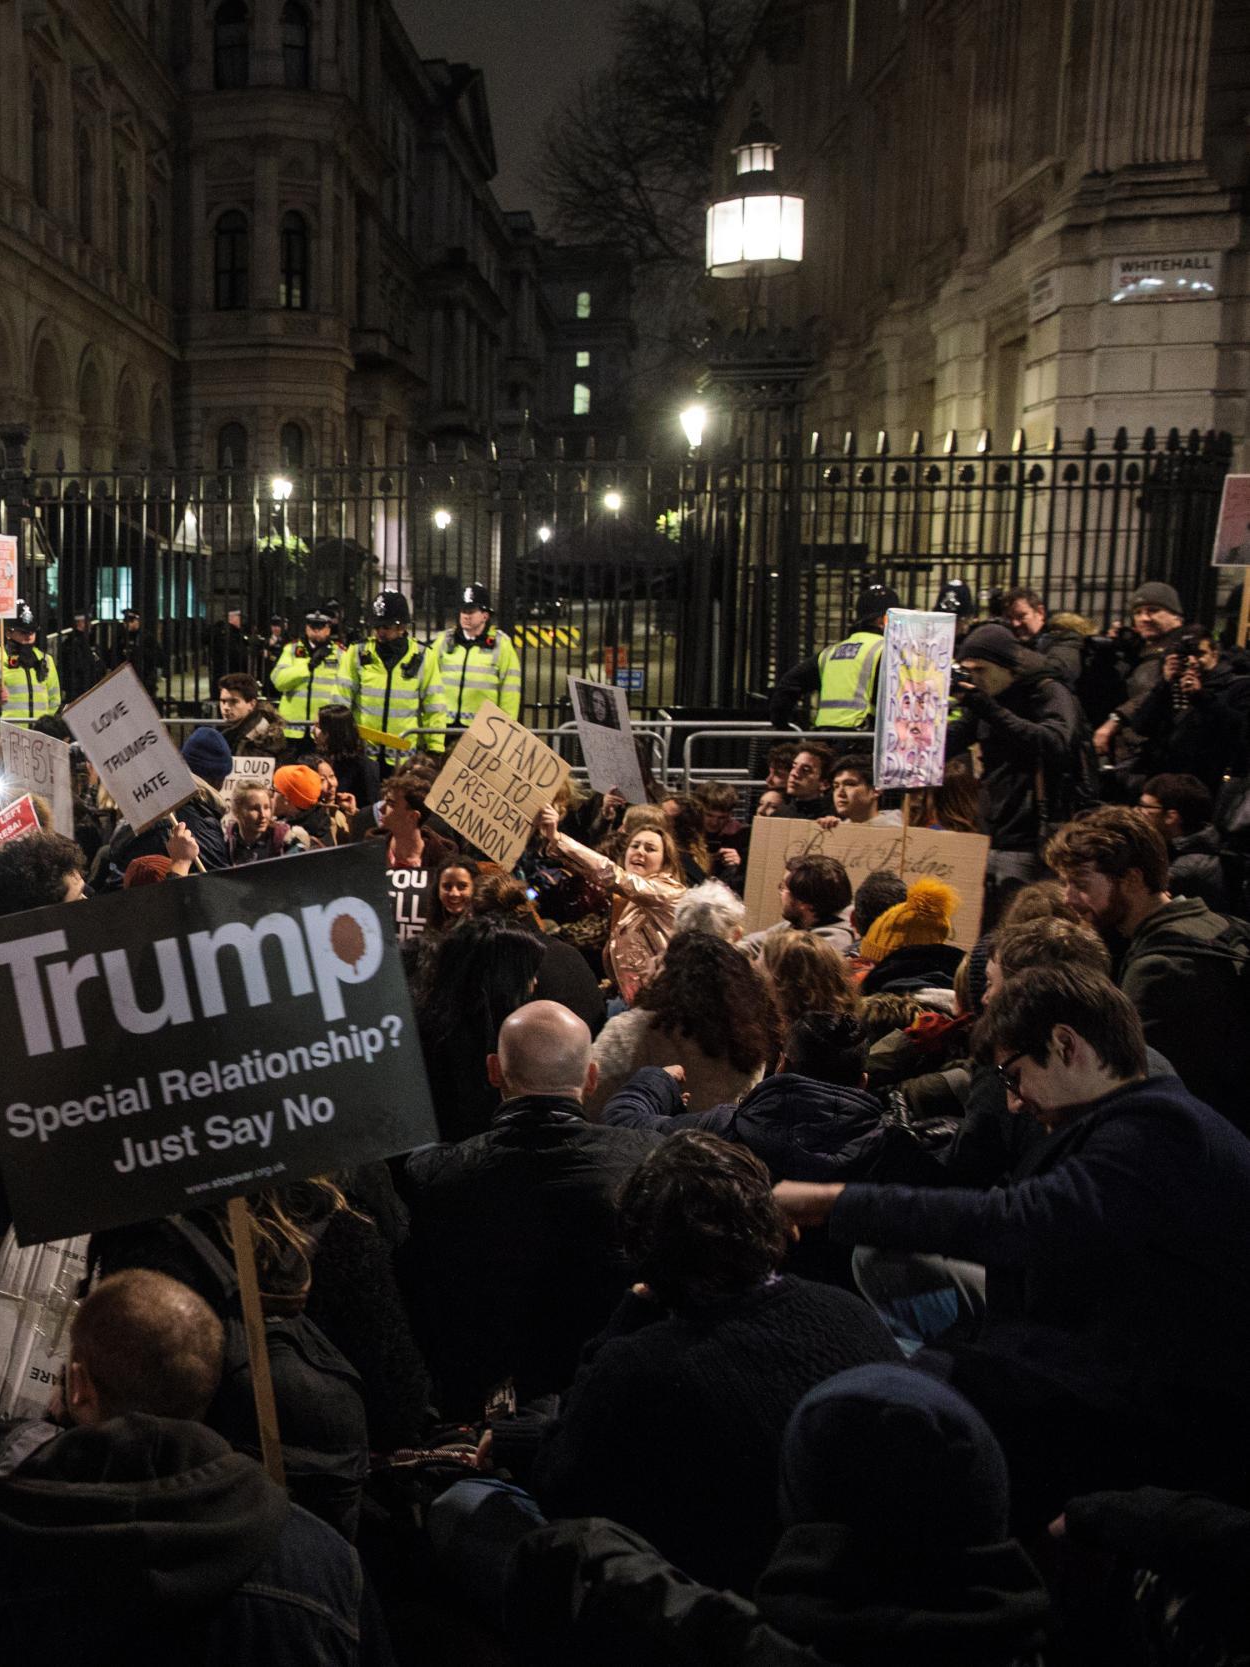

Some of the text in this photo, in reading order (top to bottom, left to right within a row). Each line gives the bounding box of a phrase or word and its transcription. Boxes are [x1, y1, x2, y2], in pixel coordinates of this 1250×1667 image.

[1120, 257, 1213, 273] WHITEHALL
[91, 699, 130, 735] LOVE
[103, 730, 159, 774] TRUMPS
[234, 759, 270, 774] LOUD
[476, 716, 560, 788] STAND
[132, 771, 170, 803] HATE
[467, 746, 532, 804] UP TO
[0, 804, 22, 824] LEFT
[452, 768, 534, 839] PRESIDENT
[435, 789, 513, 862] BANNON
[783, 828, 865, 868] Bld
[387, 890, 427, 924] LL
[4, 1014, 404, 1143] Special Relationship?
[112, 1093, 335, 1174] Just Say No
